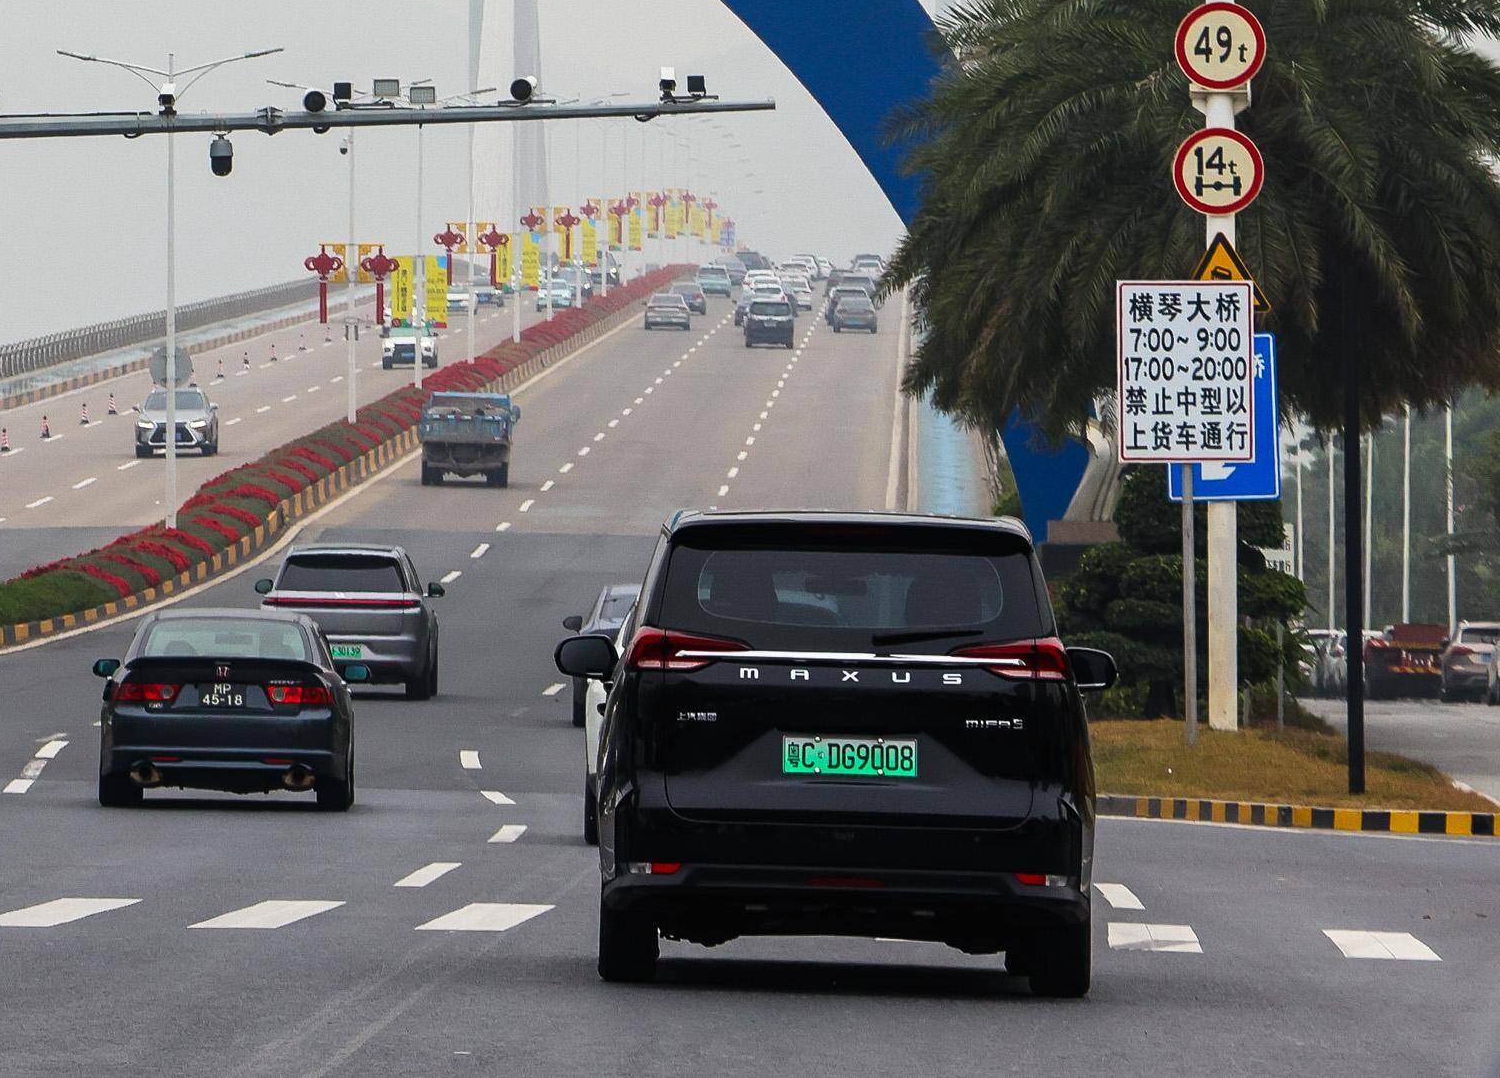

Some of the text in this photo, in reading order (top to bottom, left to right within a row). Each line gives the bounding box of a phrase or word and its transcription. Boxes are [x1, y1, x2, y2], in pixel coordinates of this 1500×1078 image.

[1129, 292, 1241, 323] 横琴大桥
[1125, 386, 1248, 417] 禁止中型以
[1126, 421, 1249, 452] 上货车通行
[739, 667, 963, 685] MAXUS
[202, 695, 243, 706] 45-18
[213, 683, 232, 695] MP
